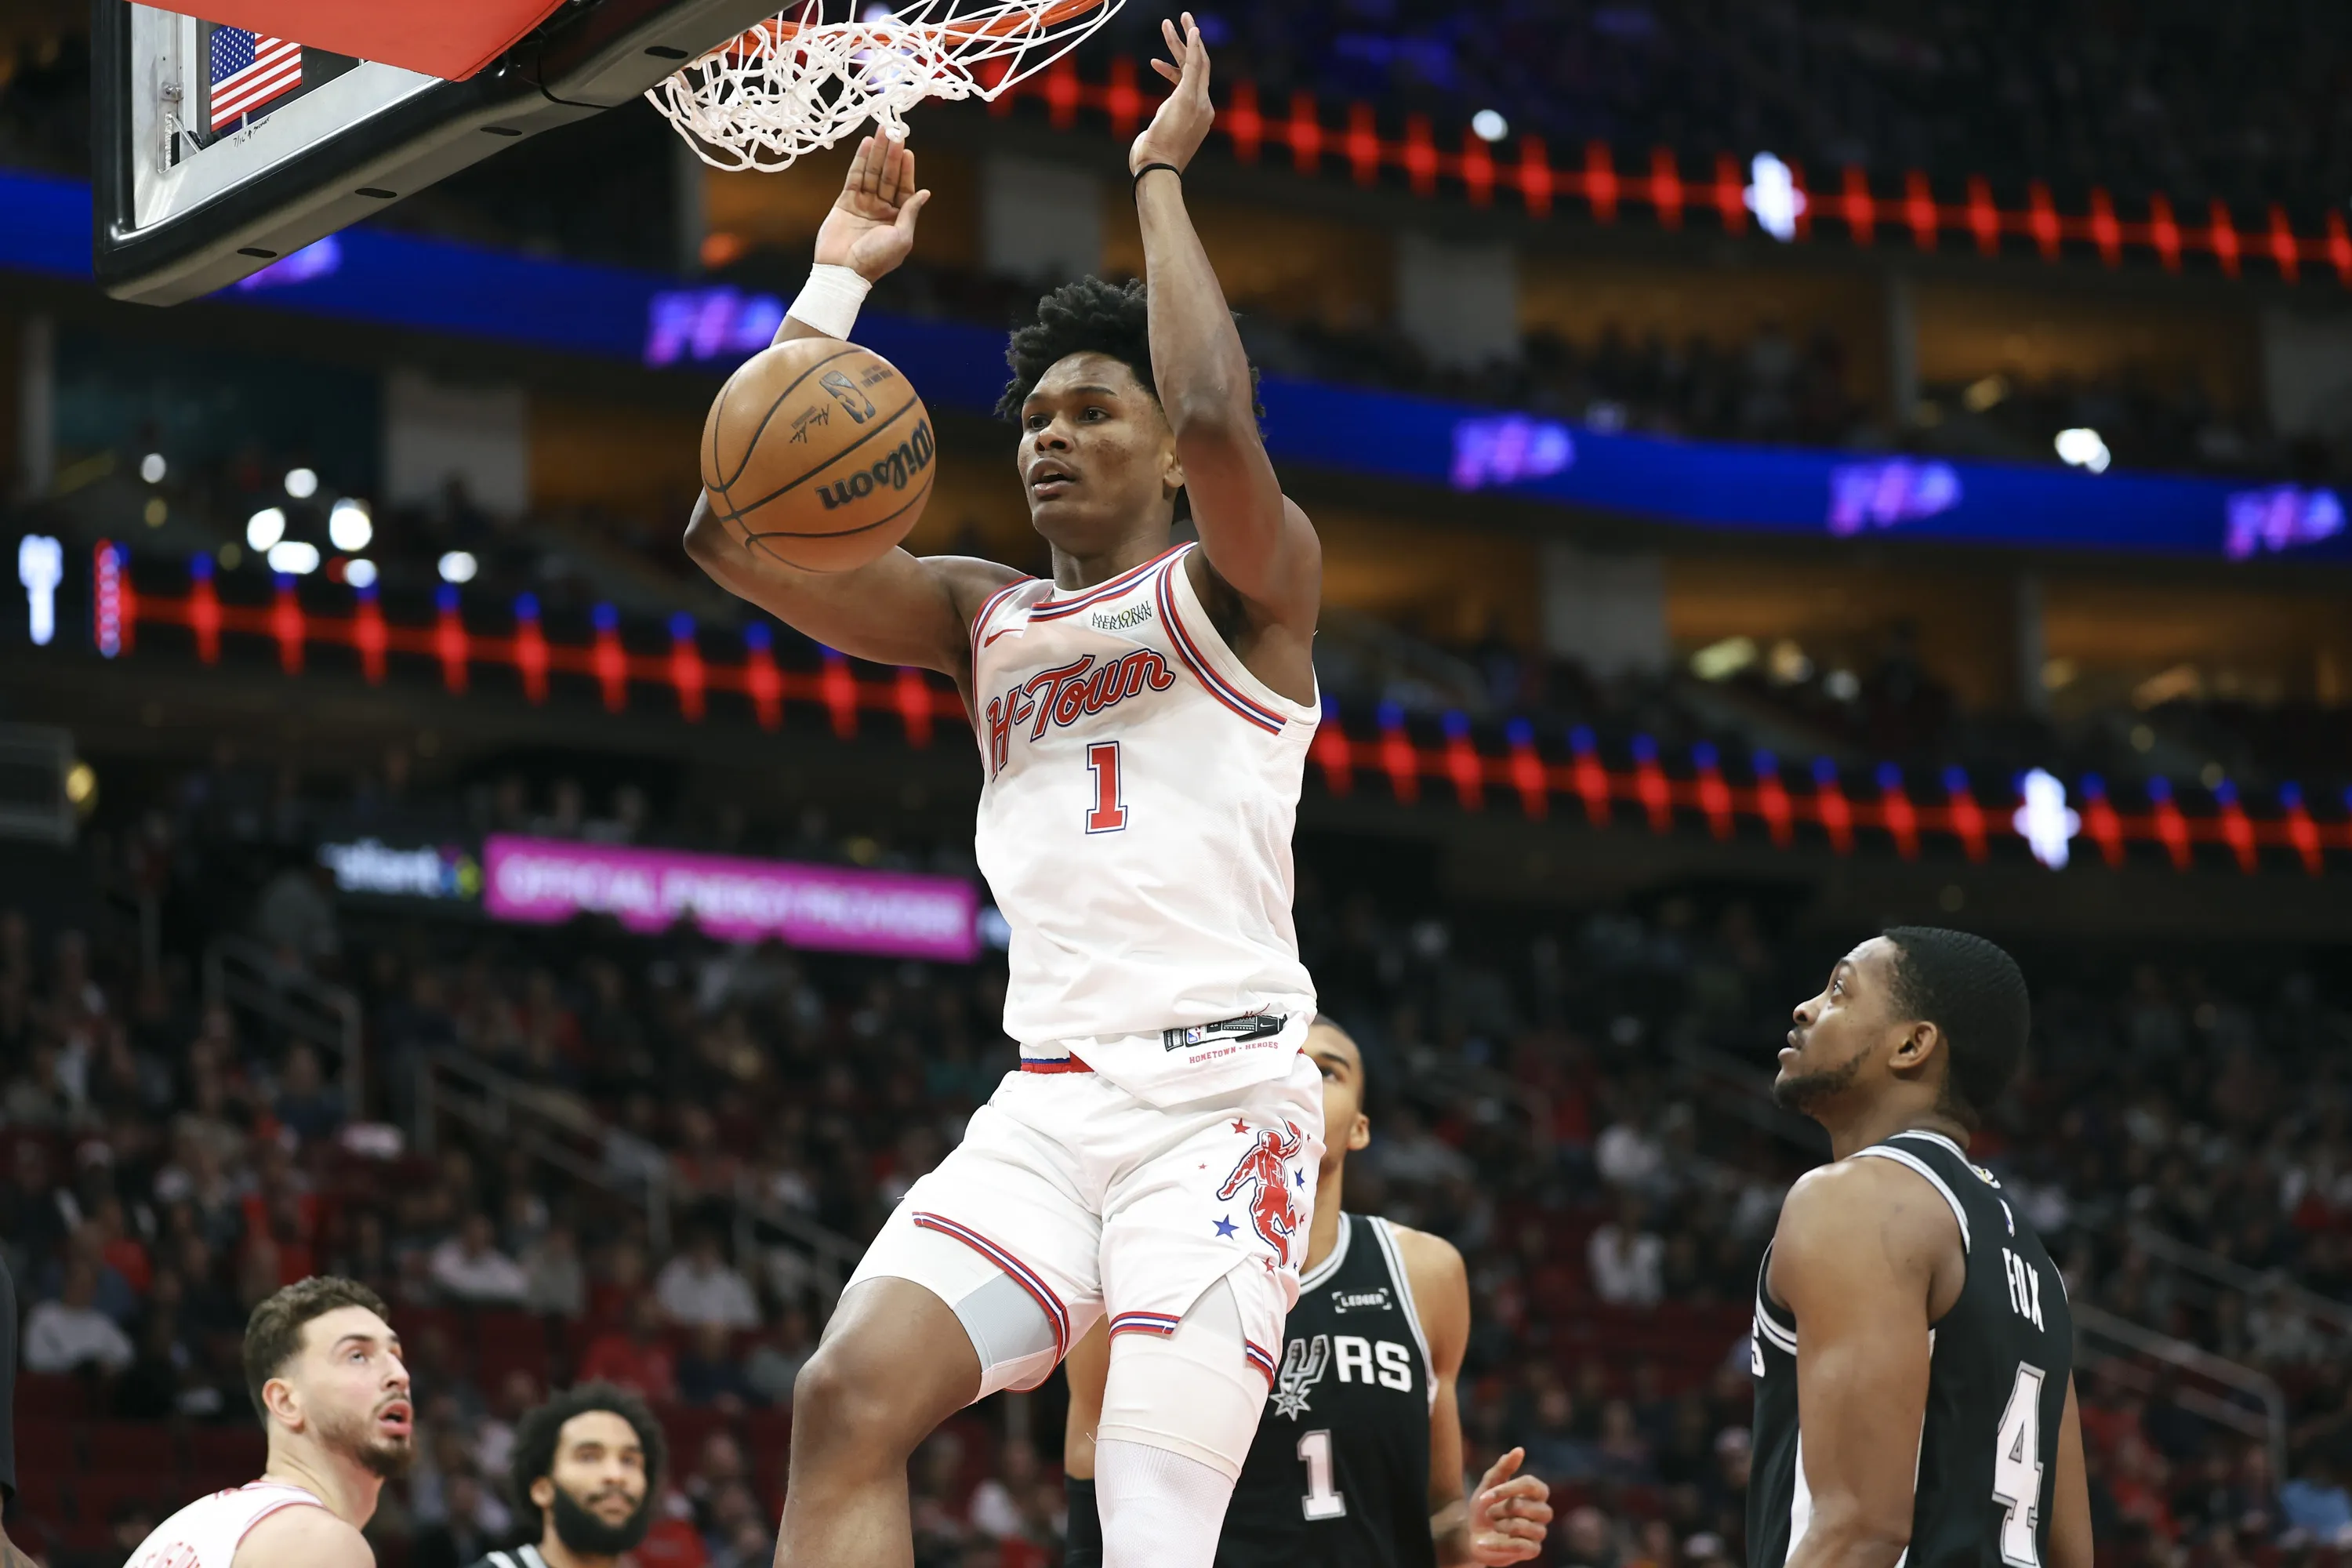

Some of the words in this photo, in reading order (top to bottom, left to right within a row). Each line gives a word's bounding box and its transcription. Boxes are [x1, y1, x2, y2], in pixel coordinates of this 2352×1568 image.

[815, 418, 935, 510] Wilson
[1092, 601, 1152, 623] MEMORIAL
[1092, 608, 1152, 630] HERMANN
[985, 648, 1176, 783] H-Town
[1086, 741, 1127, 834] 1
[1189, 1047, 1236, 1064] HOMETOWN
[1245, 1041, 1279, 1050] HEROES
[2002, 1247, 2045, 1333] FOX
[1297, 1429, 1347, 1521] 1
[1991, 1360, 2045, 1568] 4
